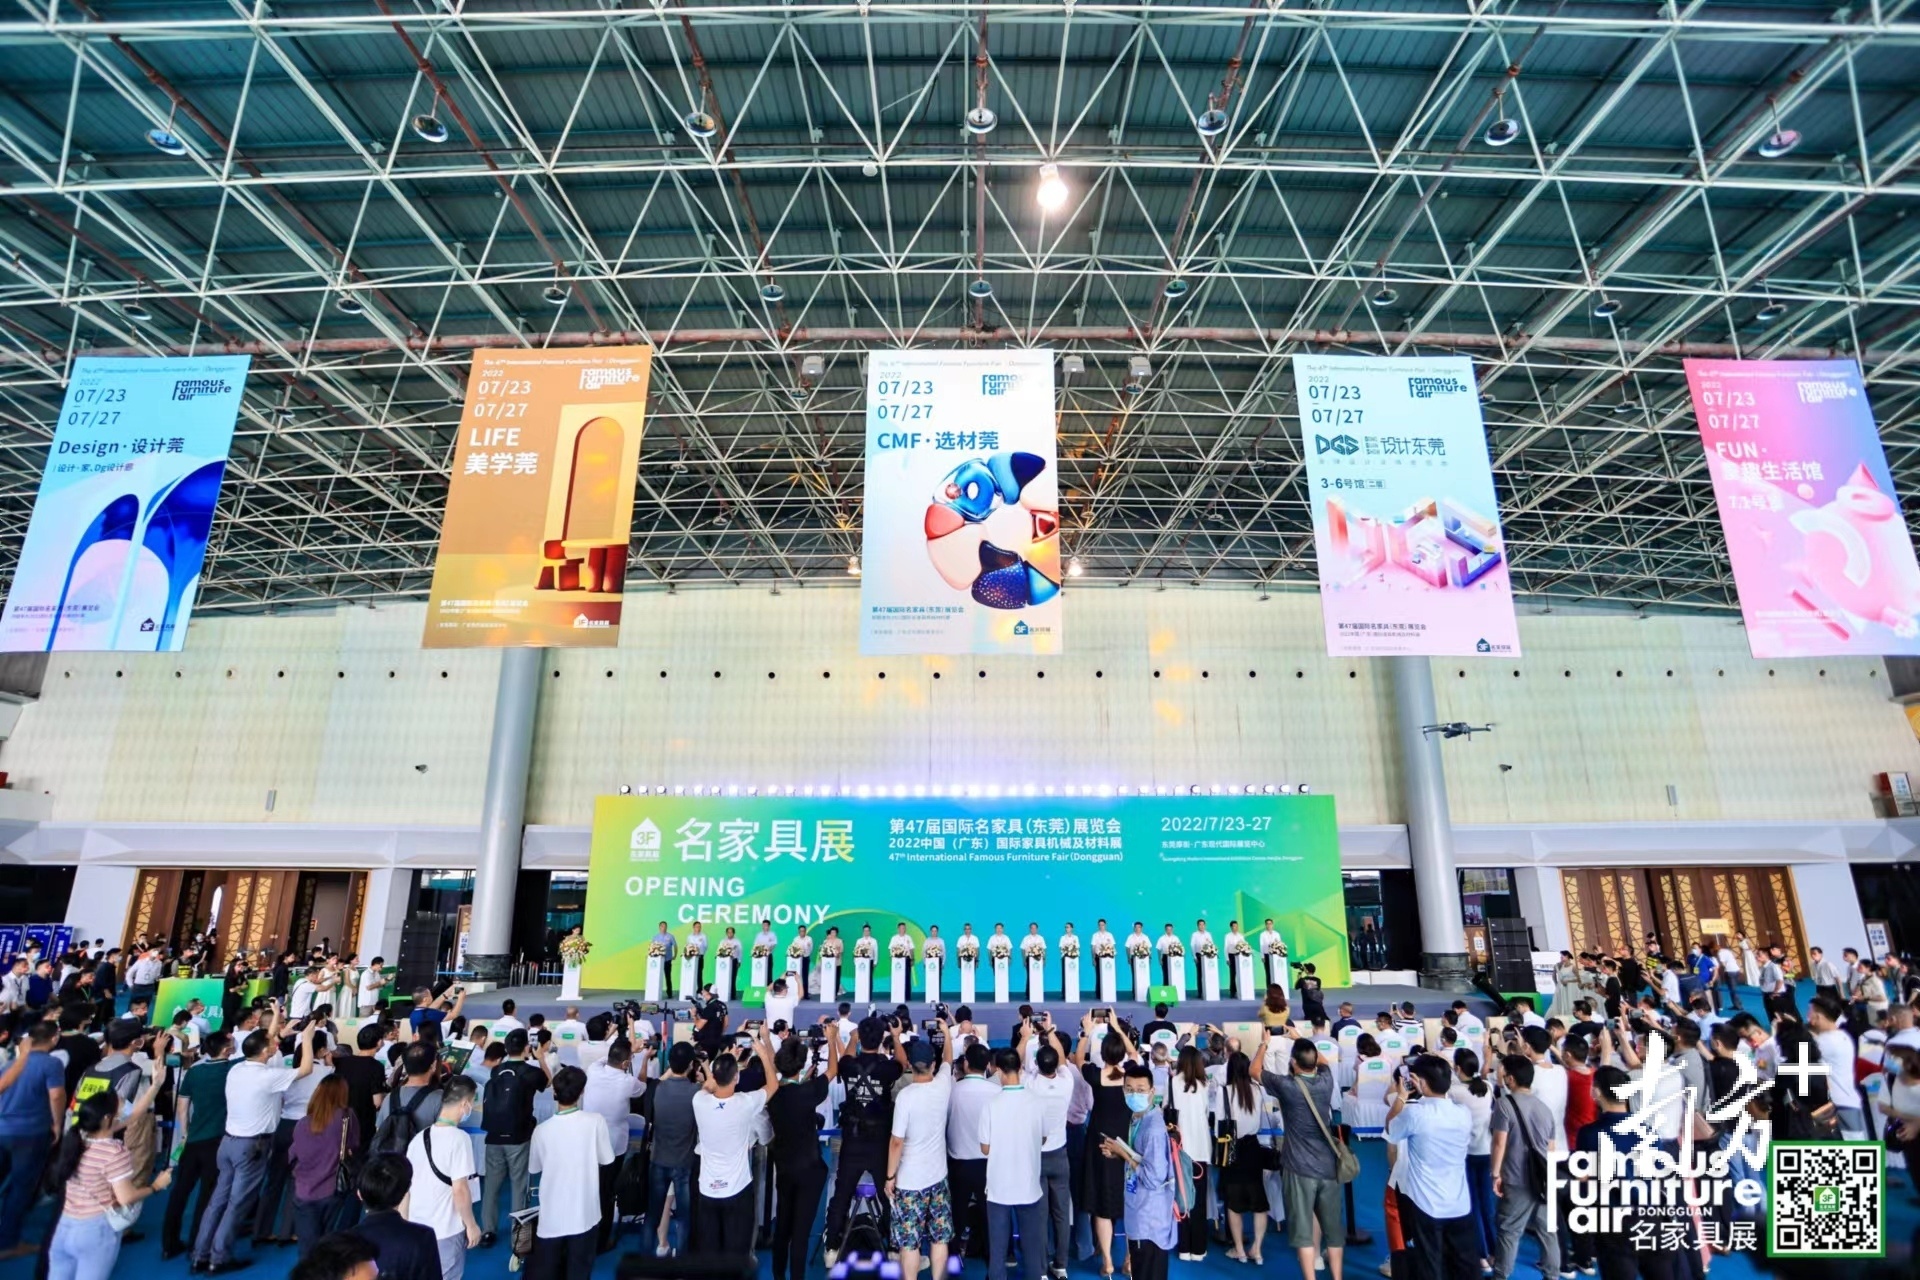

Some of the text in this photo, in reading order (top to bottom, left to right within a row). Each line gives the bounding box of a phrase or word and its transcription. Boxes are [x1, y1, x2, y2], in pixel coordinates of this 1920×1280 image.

[74, 388, 127, 404] 07/23
[478, 380, 532, 396] 07/23
[878, 381, 934, 397] 07/23
[1308, 385, 1361, 401] 07/23
[1703, 391, 1756, 408] 07/23
[68, 411, 121, 428] 07/27
[474, 403, 528, 419] 07/27
[877, 405, 933, 421] 07/27
[1312, 409, 1363, 426] 07/27
[1708, 414, 1760, 431] 07/27
[470, 428, 521, 446] LIFE
[1380, 437, 1446, 456] 设计东莞
[464, 452, 539, 475] 美学莞
[1161, 816, 1272, 831] 2022/7/23-27
[636, 831, 656, 846] 3F
[673, 817, 855, 862] 名家具展
[907, 852, 967, 862] International
[969, 853, 1005, 862] Famous
[1007, 853, 1050, 862] Furniture
[625, 877, 745, 896] OPENING
[678, 904, 831, 924] CEREMONY
